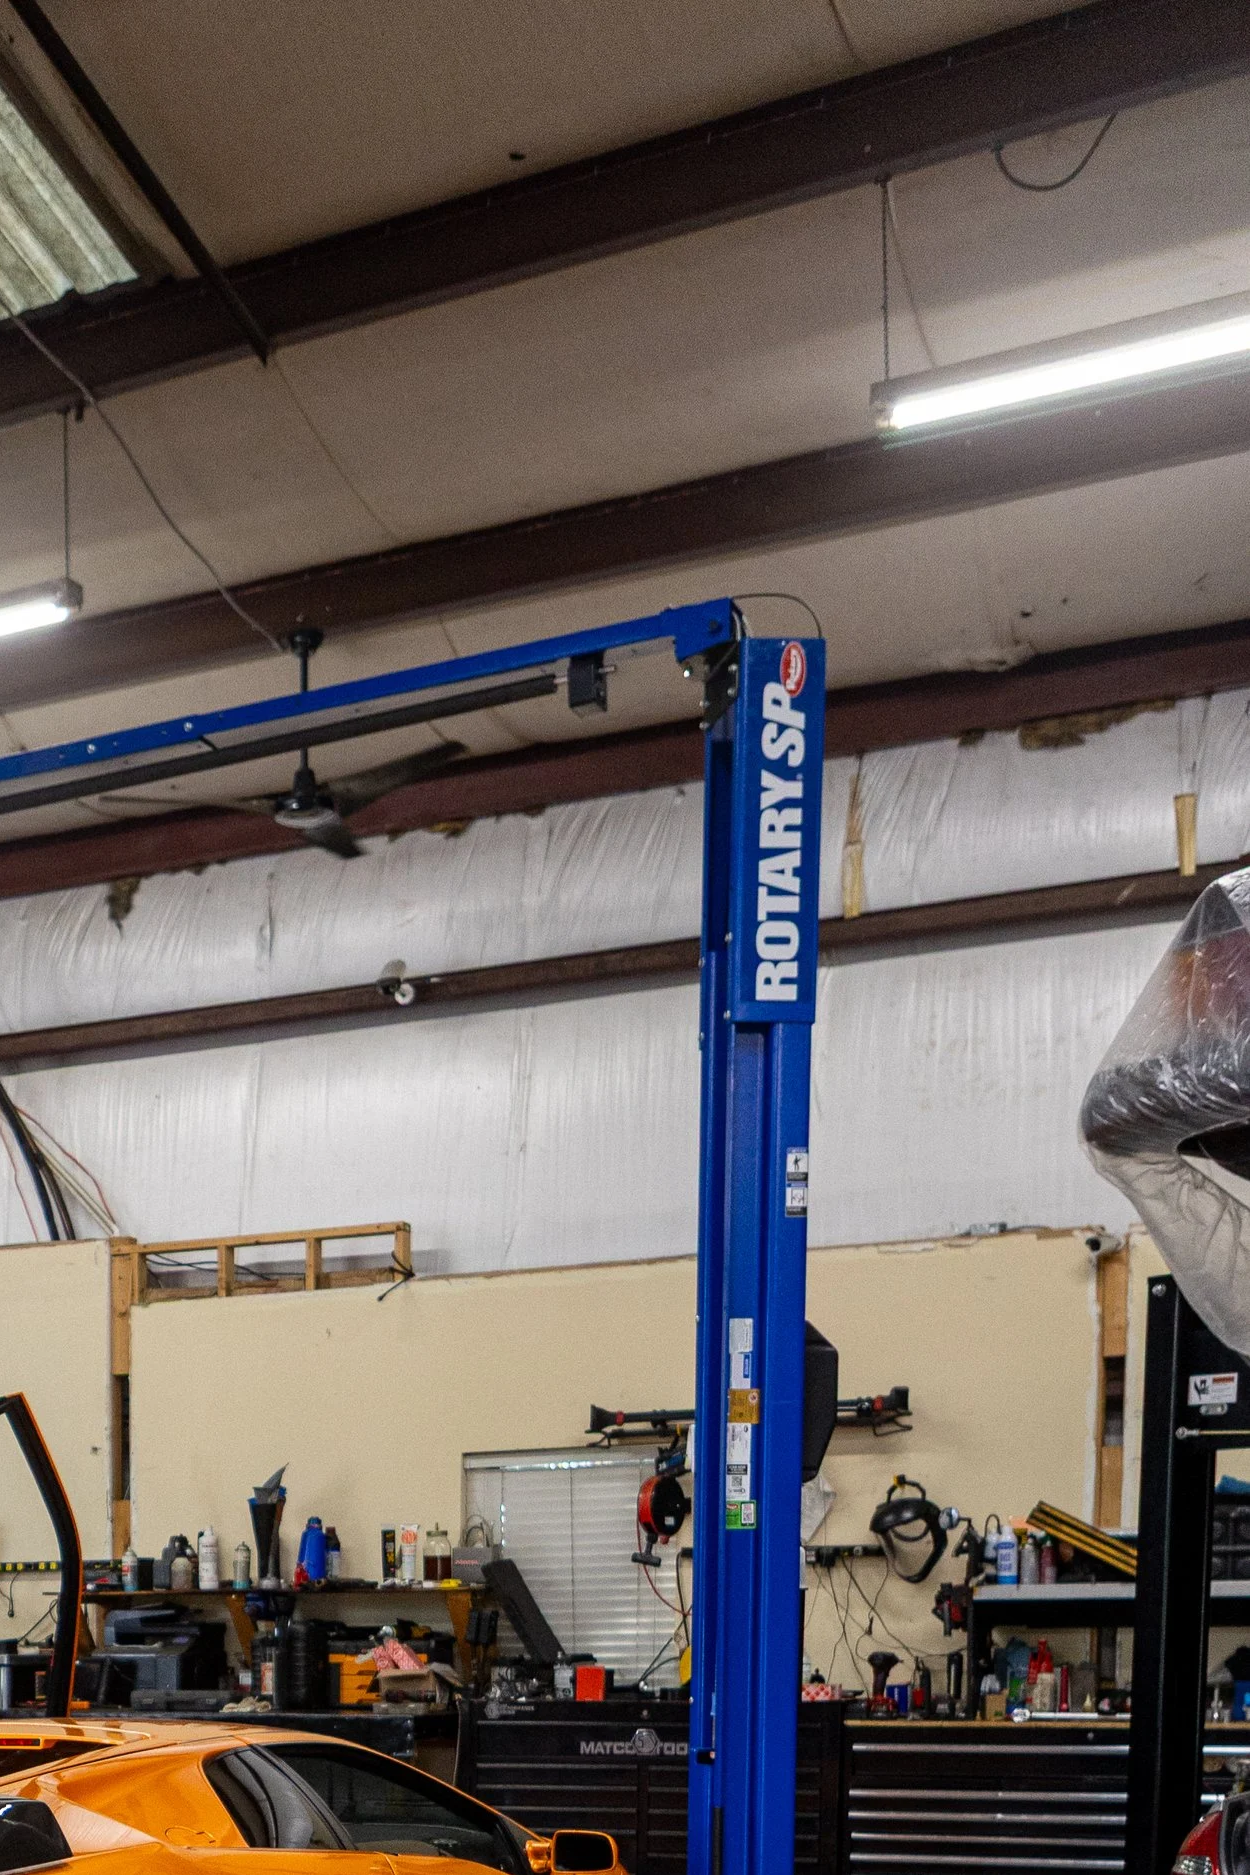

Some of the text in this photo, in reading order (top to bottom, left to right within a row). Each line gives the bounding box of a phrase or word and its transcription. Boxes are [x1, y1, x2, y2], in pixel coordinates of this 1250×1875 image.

[755, 682, 806, 1001] ROTARY SP
[579, 1740, 636, 1756] MATCO
